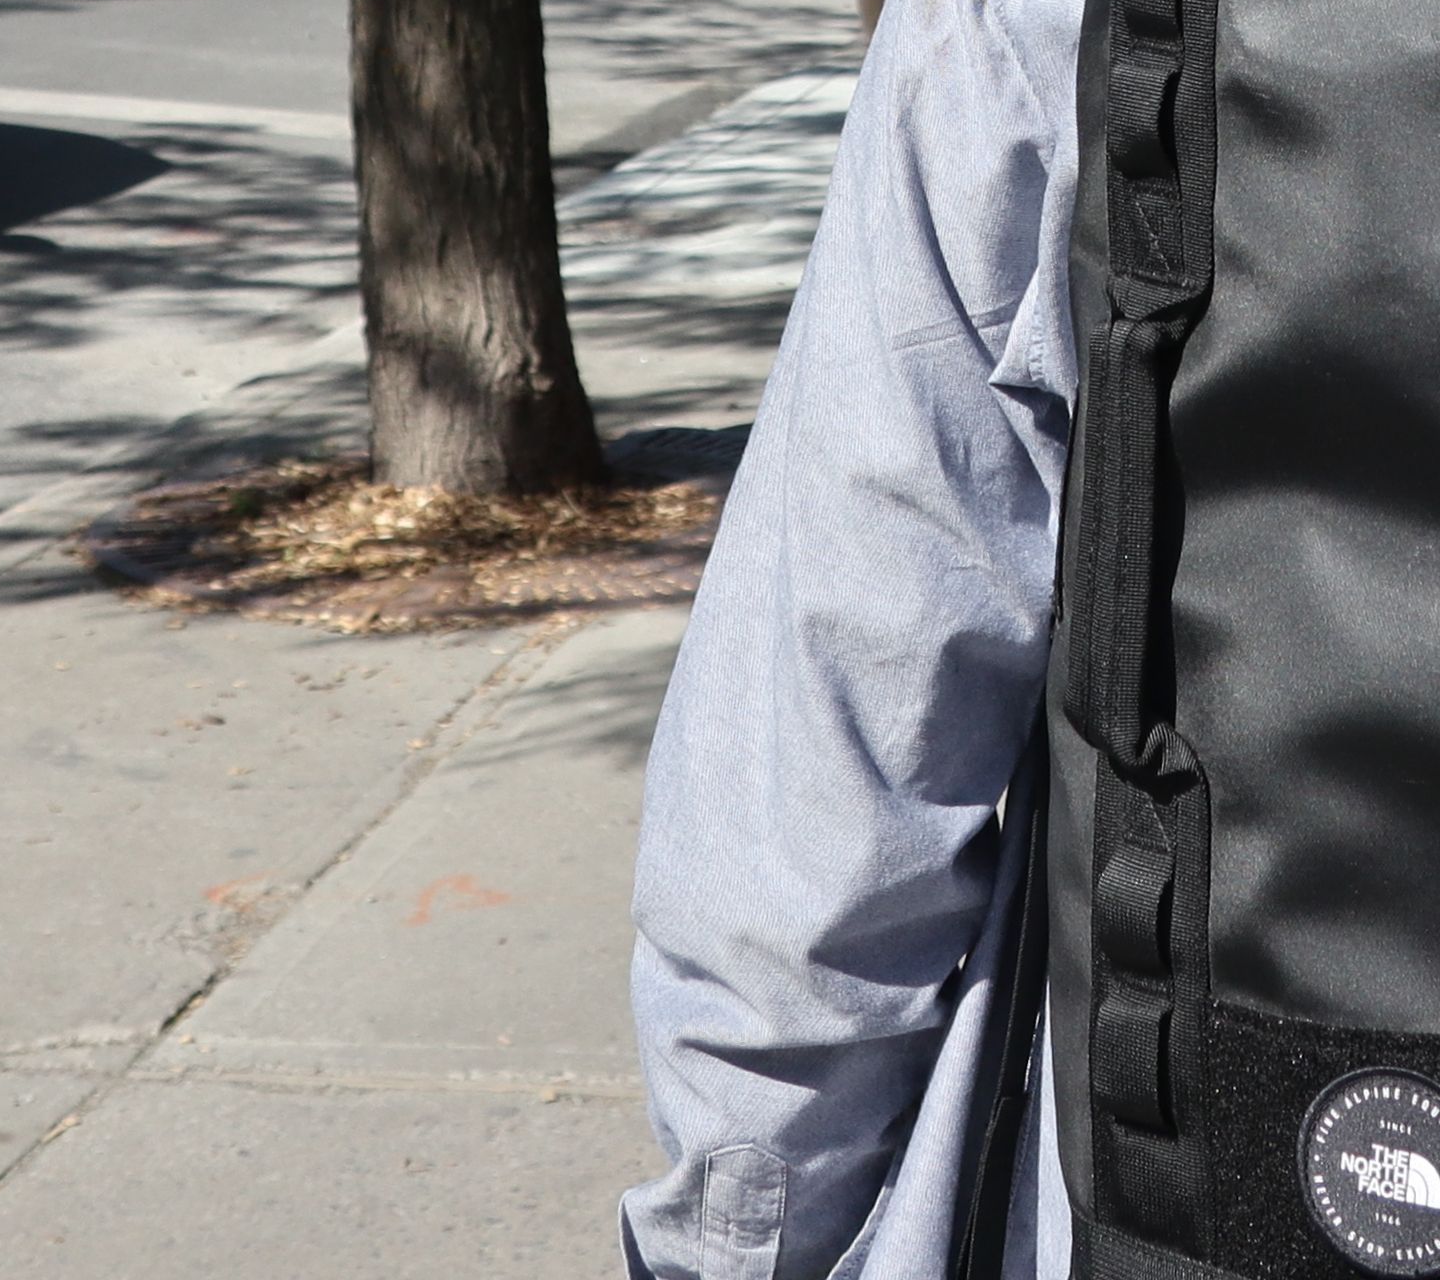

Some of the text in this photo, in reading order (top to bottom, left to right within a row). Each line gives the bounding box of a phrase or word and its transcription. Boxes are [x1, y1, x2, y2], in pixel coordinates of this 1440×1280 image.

[1344, 1086, 1401, 1110] ALPINE
[1379, 1119, 1412, 1135] SINCE
[1371, 1143, 1410, 1167] THE
[1340, 1151, 1408, 1186] NORTH
[1357, 1174, 1408, 1203] FACE
[1313, 1175, 1343, 1227] NEVER
[1347, 1230, 1385, 1258] STOP
